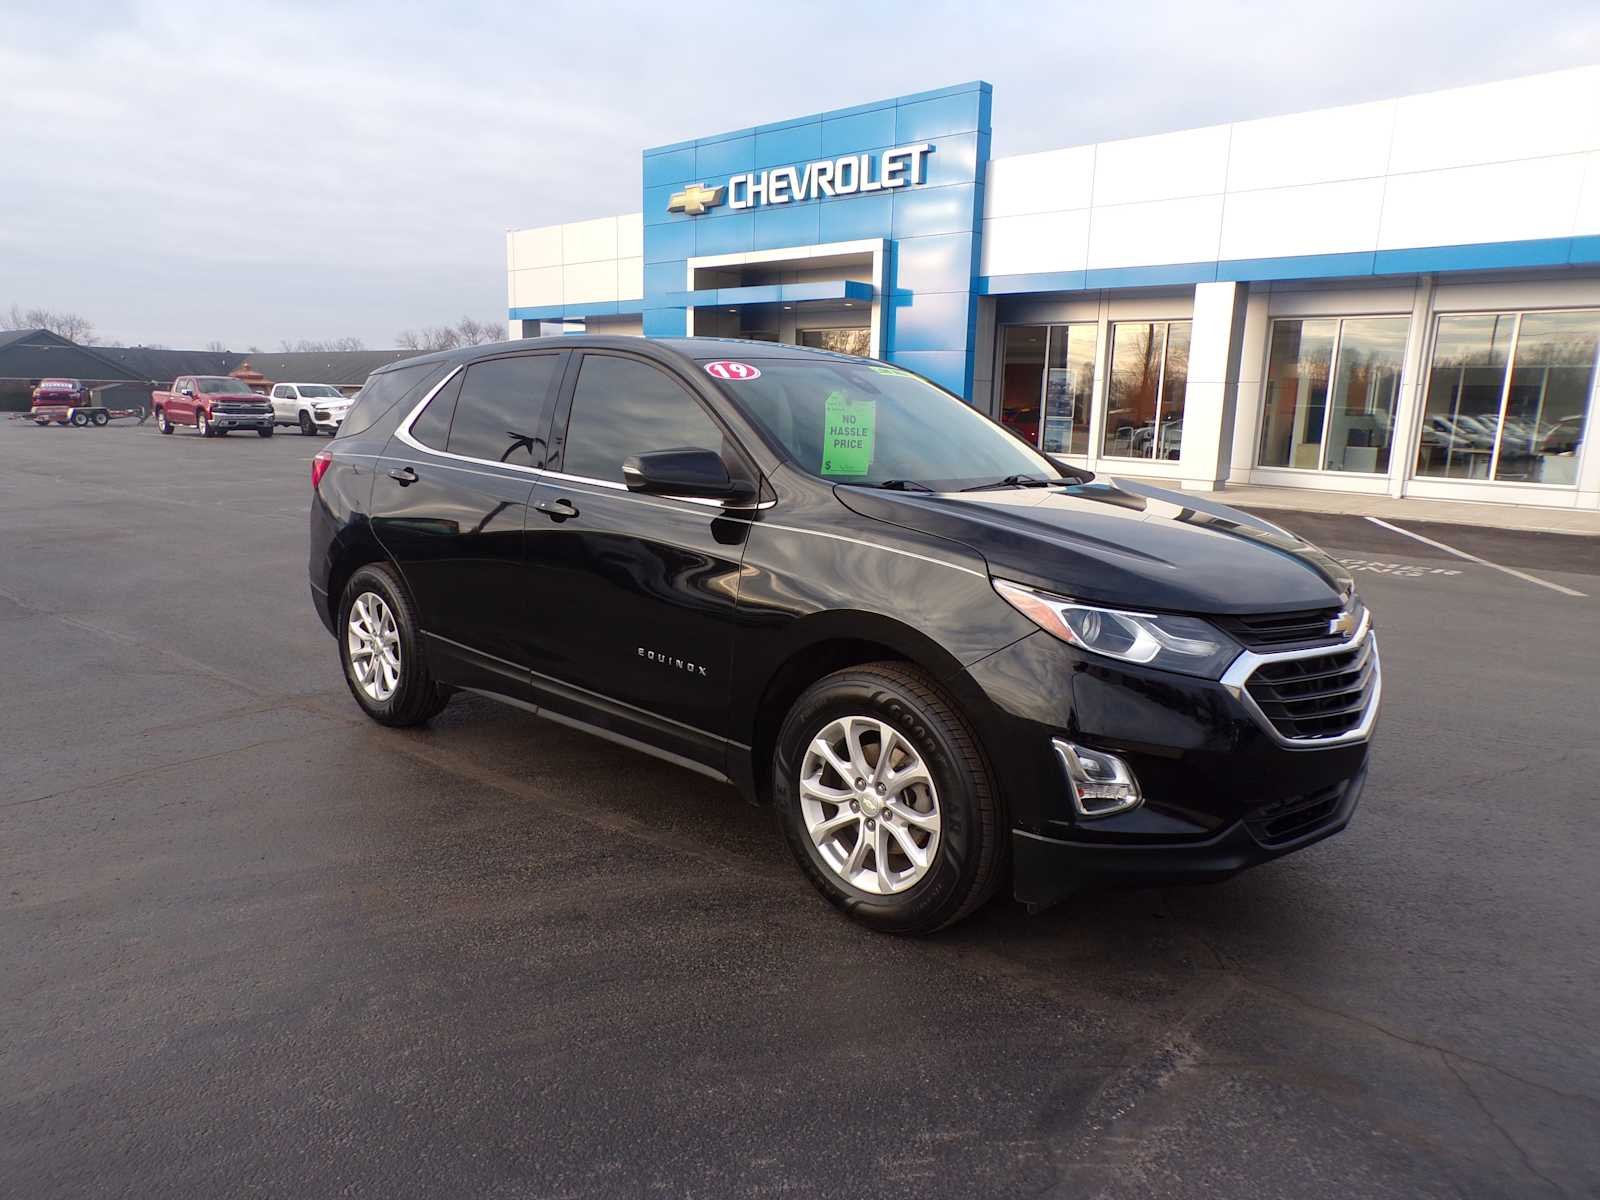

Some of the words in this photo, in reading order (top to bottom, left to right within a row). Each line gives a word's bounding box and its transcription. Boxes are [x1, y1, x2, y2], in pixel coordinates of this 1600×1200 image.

[728, 142, 934, 210] CHEVROLET
[713, 363, 748, 378] 19
[842, 415, 857, 425] NO
[830, 426, 869, 437] HASSLE
[833, 439, 863, 449] PRICE
[637, 647, 707, 676] EQUINOX
